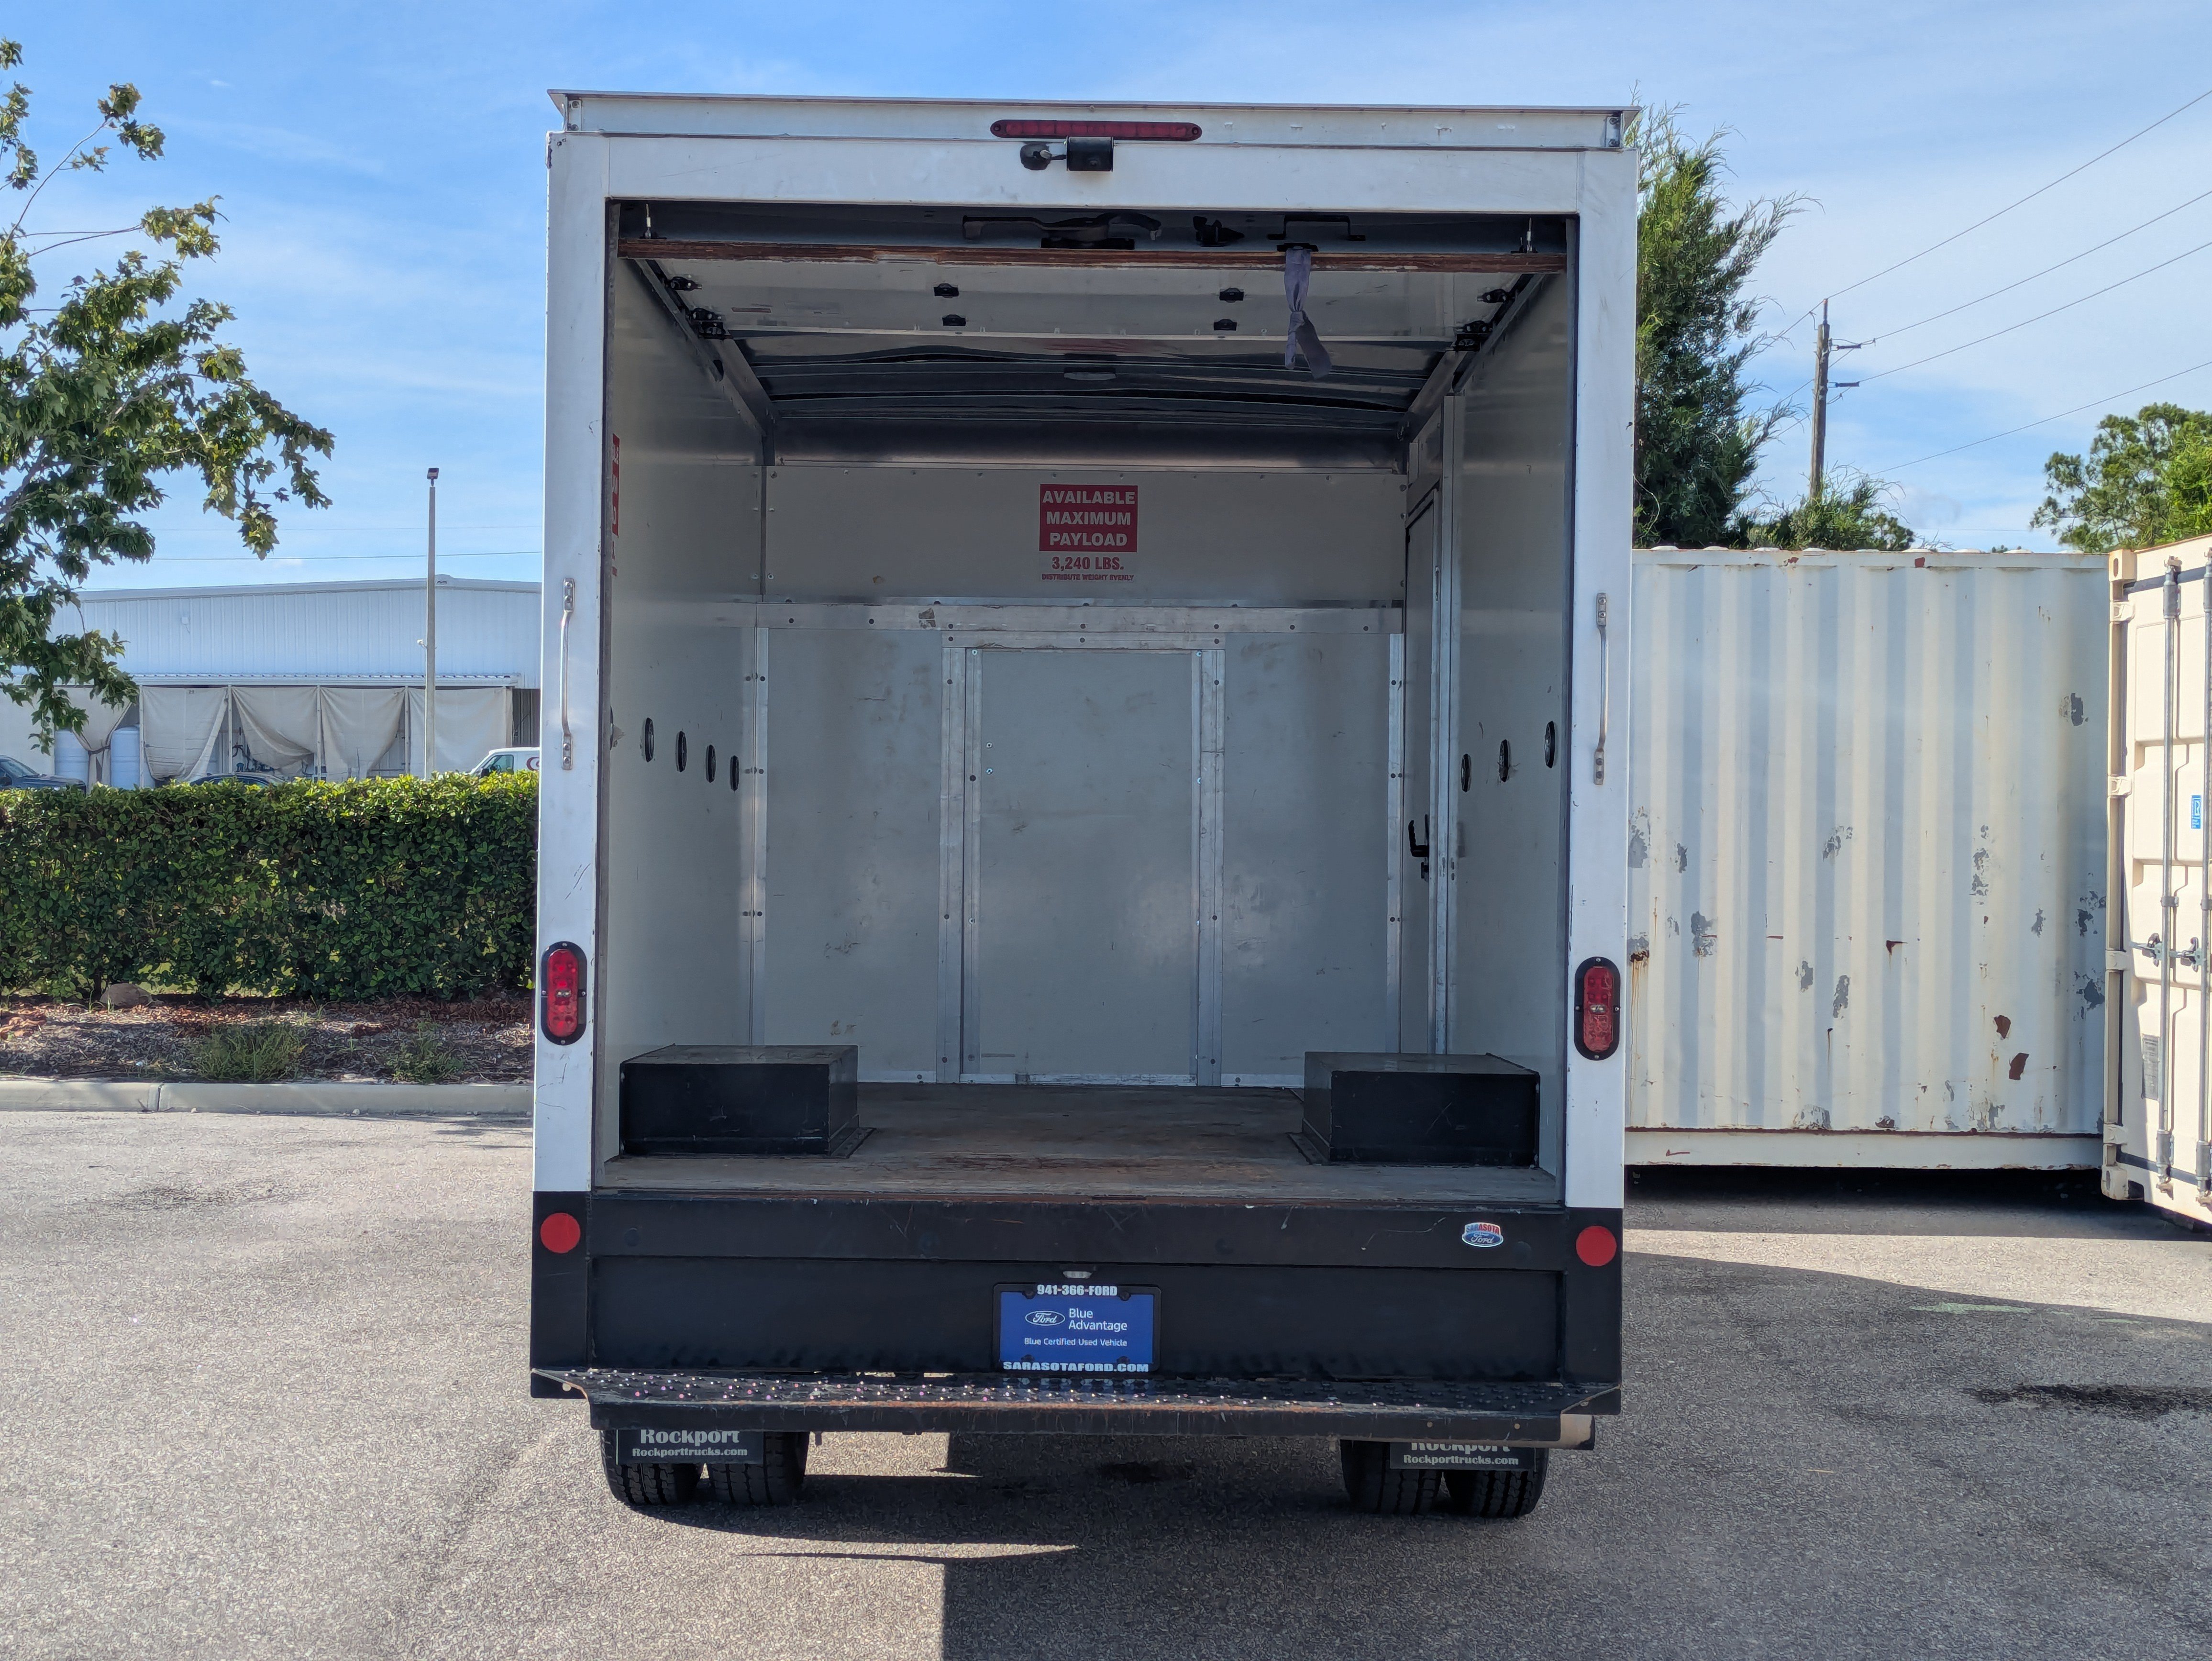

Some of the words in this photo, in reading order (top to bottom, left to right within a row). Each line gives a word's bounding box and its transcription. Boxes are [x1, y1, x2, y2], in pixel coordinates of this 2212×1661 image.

[1042, 490, 1135, 505] AVAILABLE
[1046, 511, 1130, 525] MAXIMUM
[1050, 532, 1128, 546] PAYLOAD
[1051, 556, 1090, 571] 3,240
[1095, 557, 1124, 570] LBS.
[1466, 1223, 1500, 1235] SARASOTA
[1471, 1233, 1495, 1243] Ford
[1037, 1284, 1118, 1296] 941-366-FORD
[1032, 1311, 1057, 1324] Ford
[1069, 1308, 1094, 1319] Blue
[1068, 1319, 1128, 1332] Advantage
[1043, 1338, 1076, 1346] Certified
[1078, 1338, 1098, 1346] Used
[1100, 1339, 1128, 1347] Vehicle
[1003, 1361, 1149, 1372] SARASOTAFORD.COM
[640, 1428, 740, 1446] Rockport
[632, 1447, 748, 1458] Rockporttrucks.com
[1403, 1455, 1519, 1465] Rockporttrucks.com
